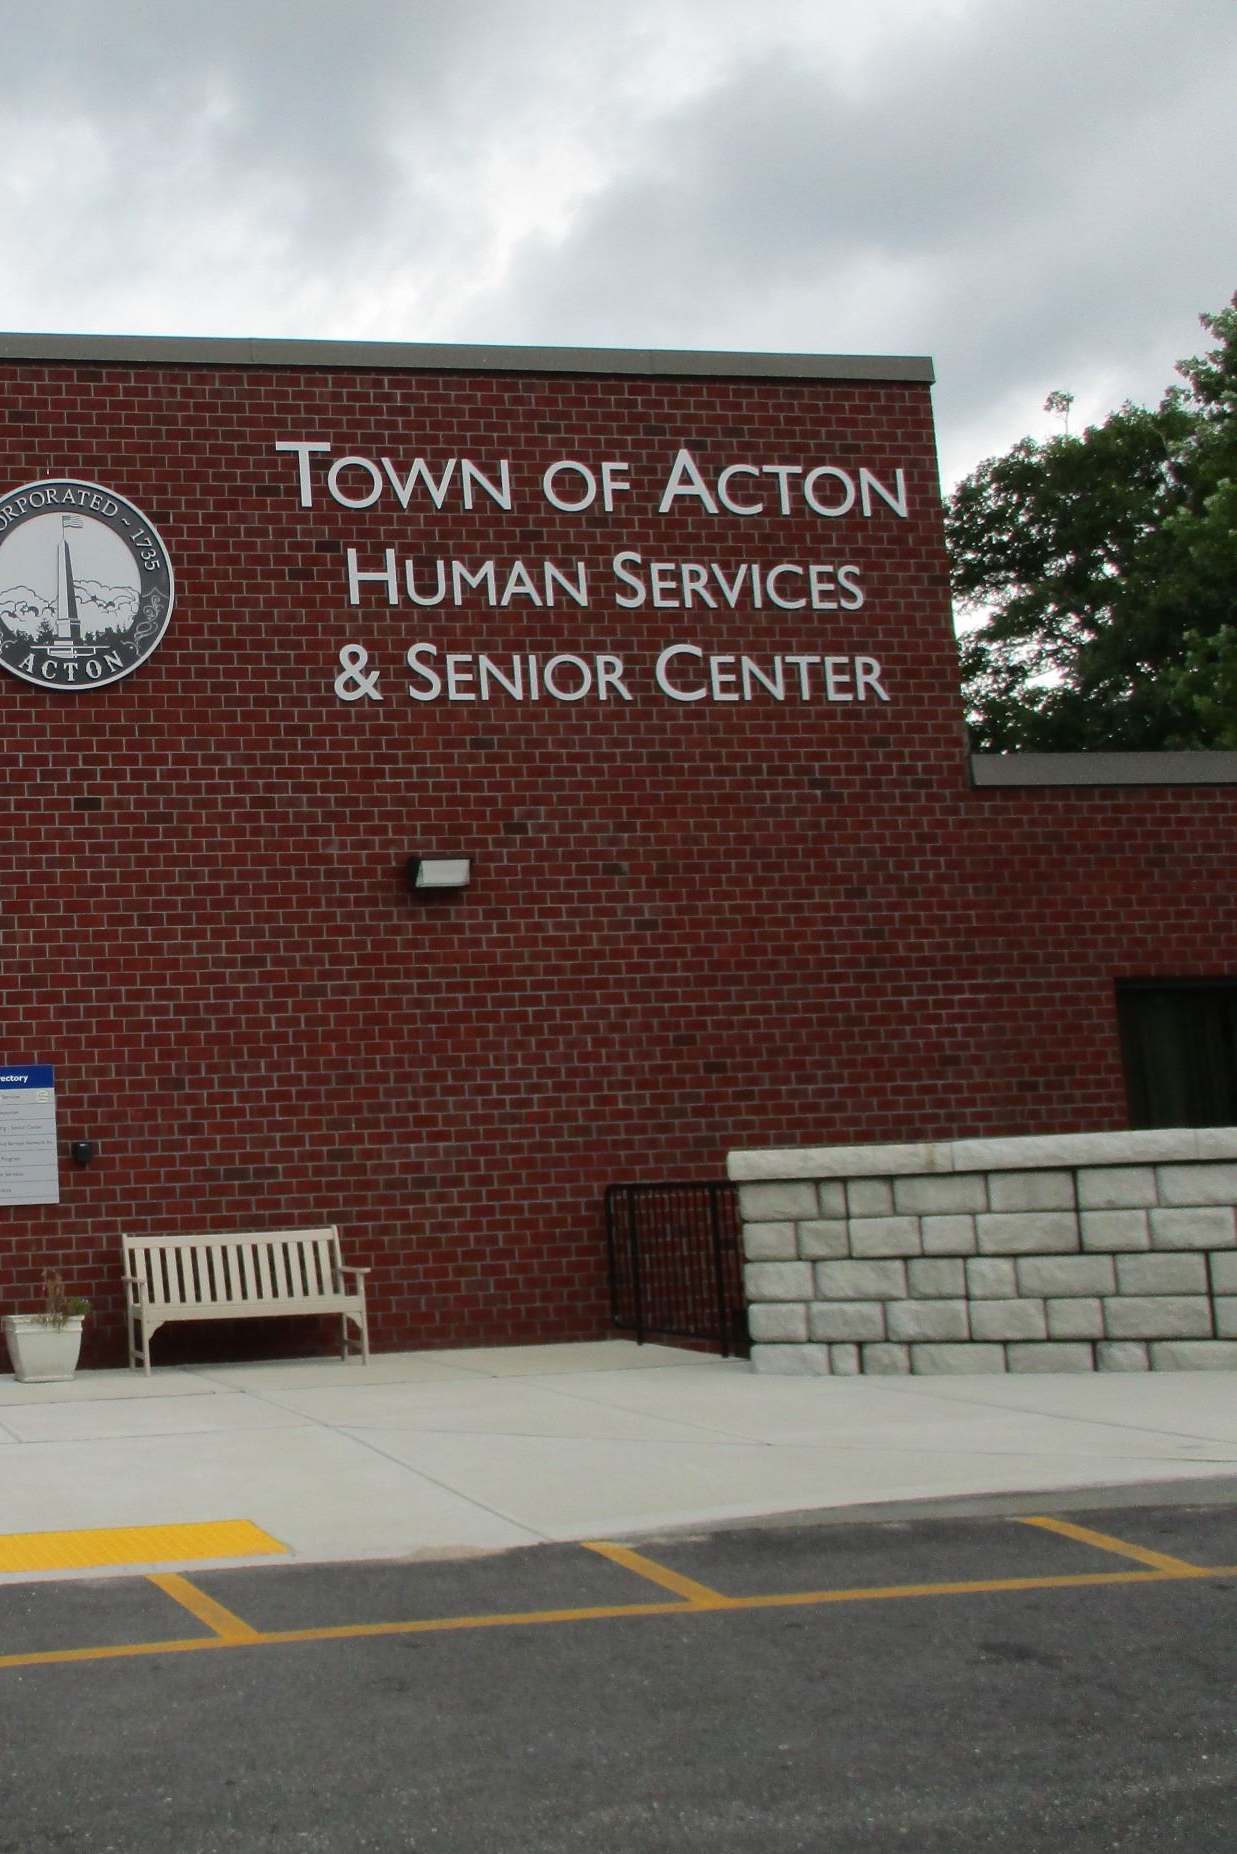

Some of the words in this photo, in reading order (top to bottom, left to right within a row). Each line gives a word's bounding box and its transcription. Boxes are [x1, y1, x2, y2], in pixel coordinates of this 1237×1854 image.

[275, 441, 512, 510] TOWN
[542, 460, 629, 512] OF
[658, 448, 908, 518] ACTON
[129, 527, 161, 571] 1735
[346, 547, 589, 607] HUMAN
[612, 550, 864, 610] SERVICES
[18, 650, 124, 682] ACTON
[333, 643, 384, 702] &
[406, 642, 634, 702] SENIOR
[655, 643, 891, 702] CENTER
